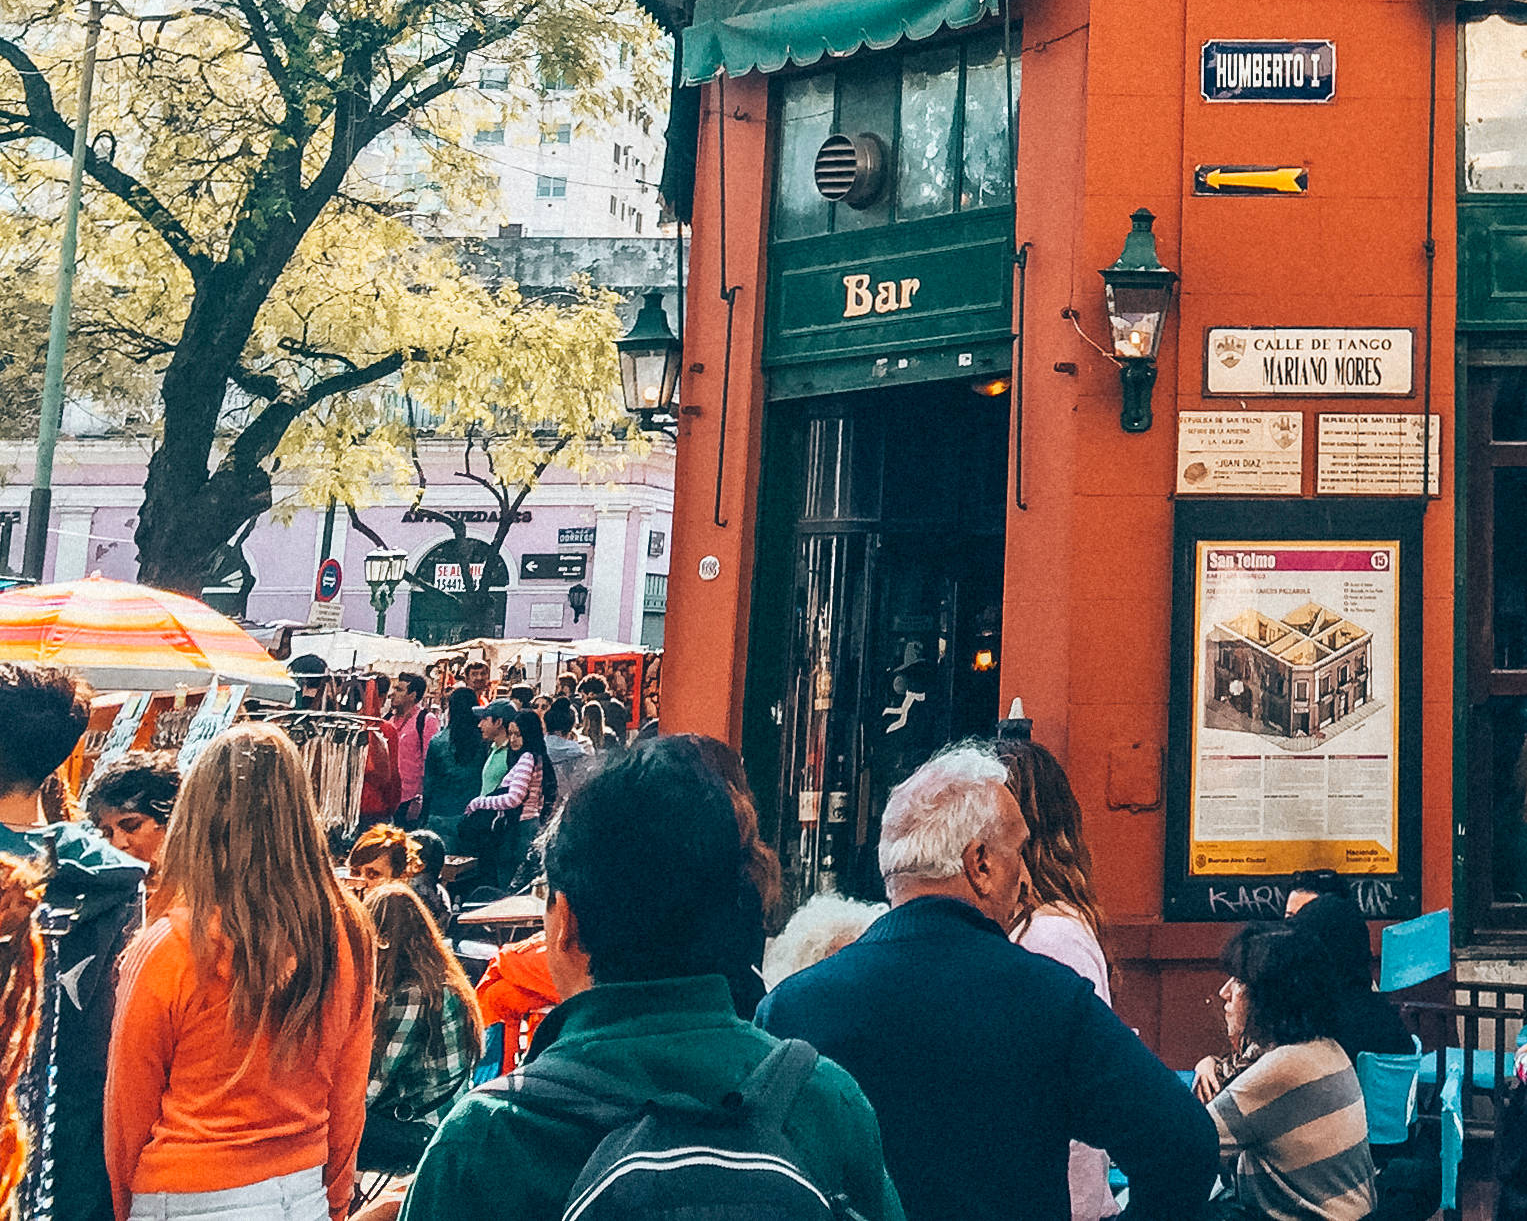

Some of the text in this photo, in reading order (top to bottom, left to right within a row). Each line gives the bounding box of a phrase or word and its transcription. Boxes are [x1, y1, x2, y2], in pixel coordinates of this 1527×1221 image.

[1216, 53, 1321, 89] HUMBERTO I
[842, 273, 921, 319] Bar
[1254, 338, 1393, 352] CALLE DE TANGO
[1263, 356, 1383, 387] MARIANO MORES
[438, 566, 448, 576] SE
[1209, 553, 1385, 569] San Telmo 15
